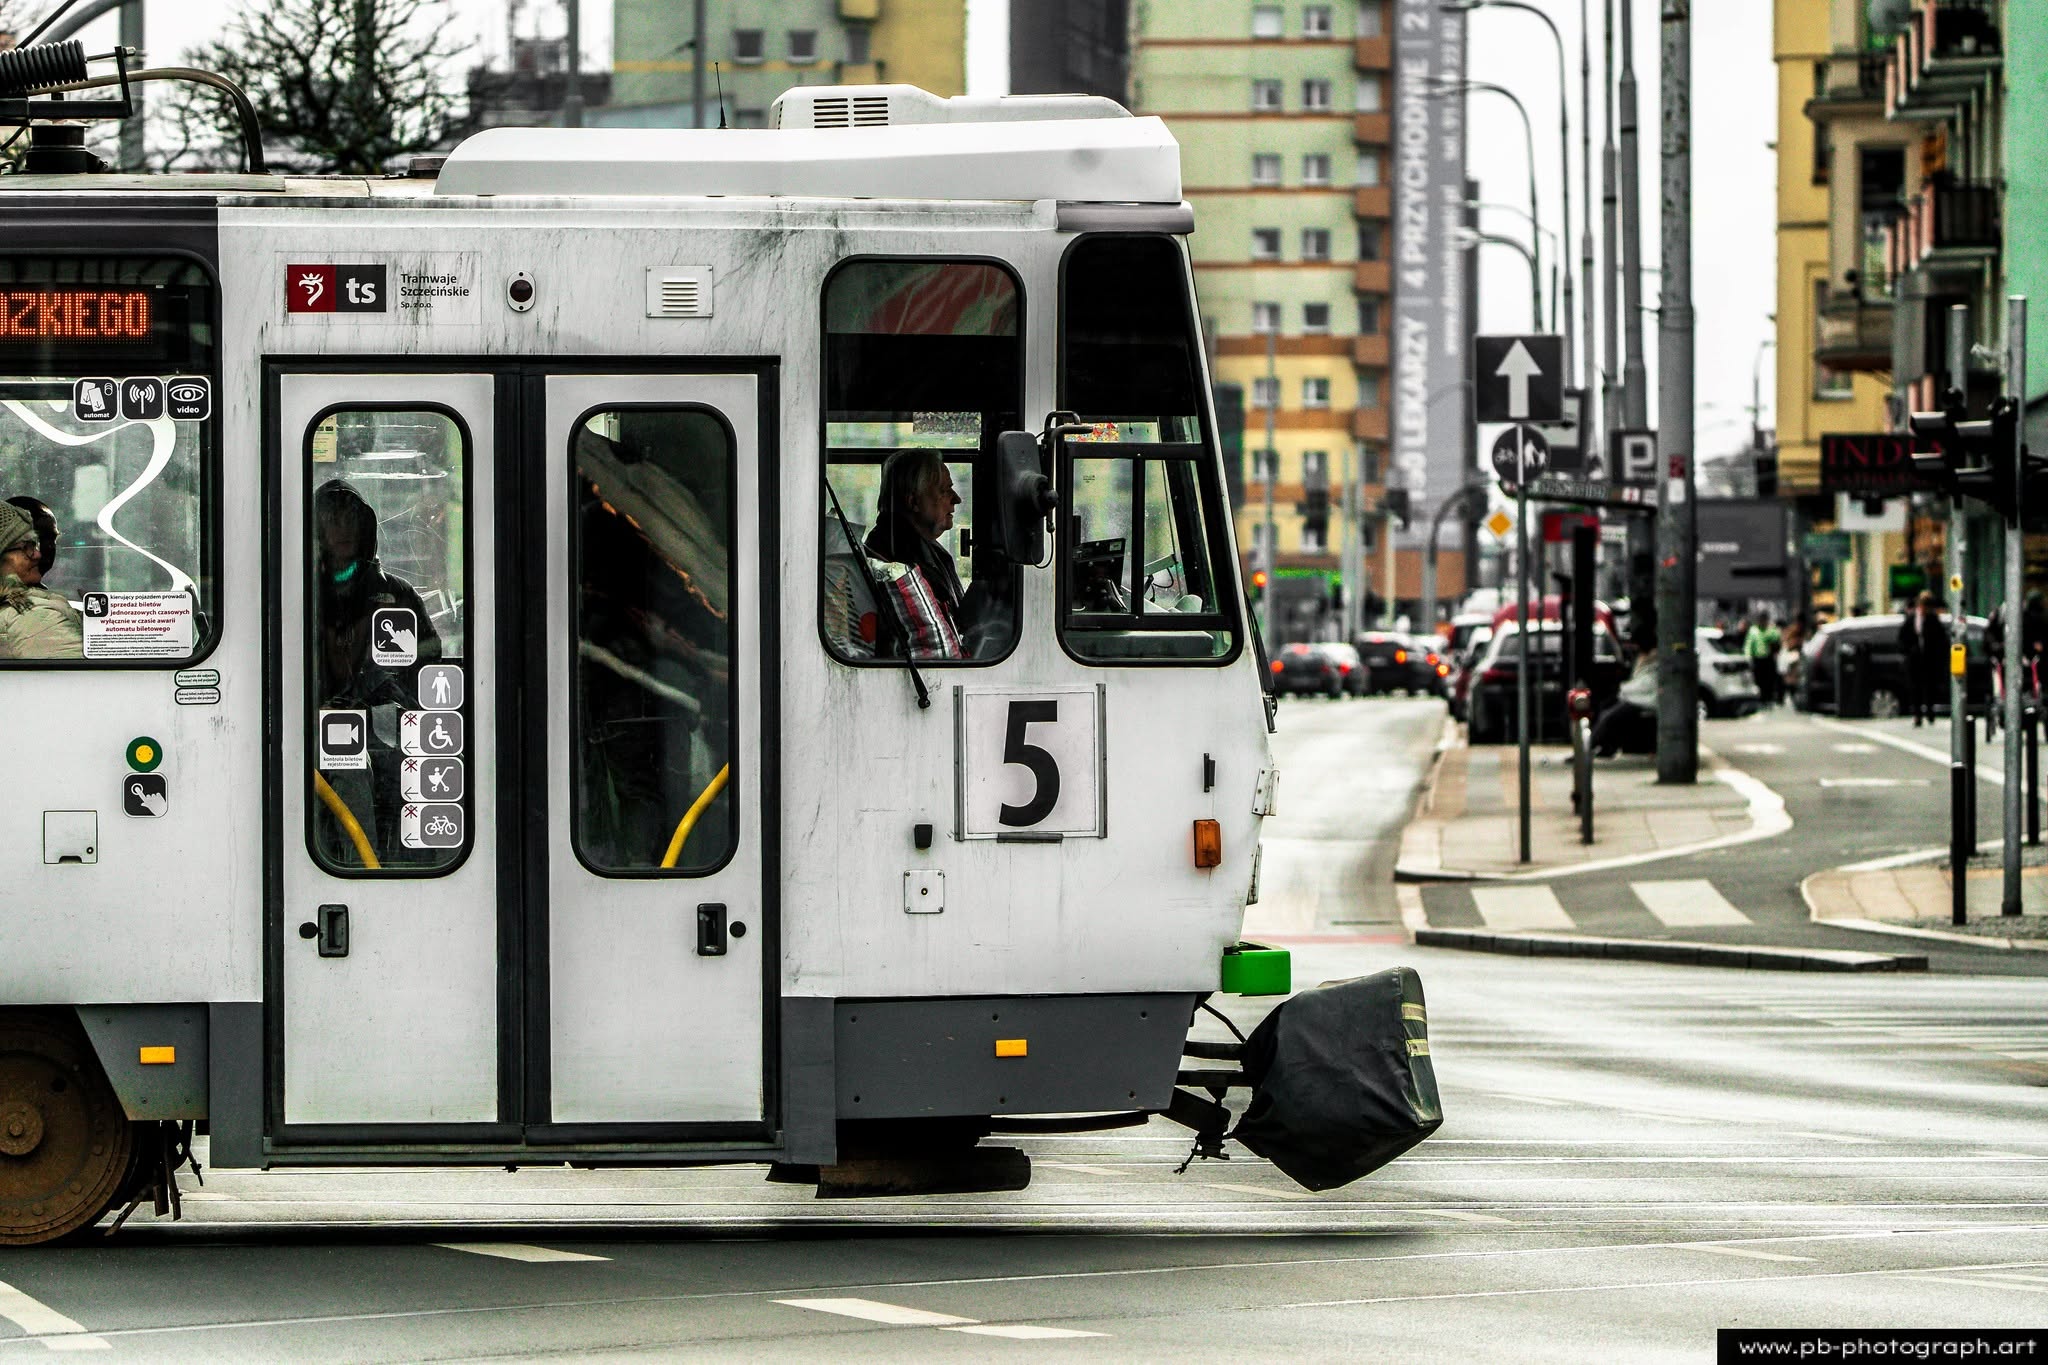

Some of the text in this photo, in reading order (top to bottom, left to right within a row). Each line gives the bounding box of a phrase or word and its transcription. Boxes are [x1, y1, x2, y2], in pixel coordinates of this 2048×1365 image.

[1402, 13, 1429, 31] 2
[1400, 60, 1428, 265] PRZYCHODNIE
[345, 277, 376, 304] ts
[401, 273, 457, 286] Tramwaje
[401, 285, 469, 297] Szczecińskie
[1401, 271, 1427, 290] 4
[0, 293, 147, 335] ZKIEGO
[401, 301, 412, 309] Sp.
[1400, 317, 1428, 448] LEKARZY
[1624, 436, 1653, 479] P
[998, 700, 1060, 827] 5
